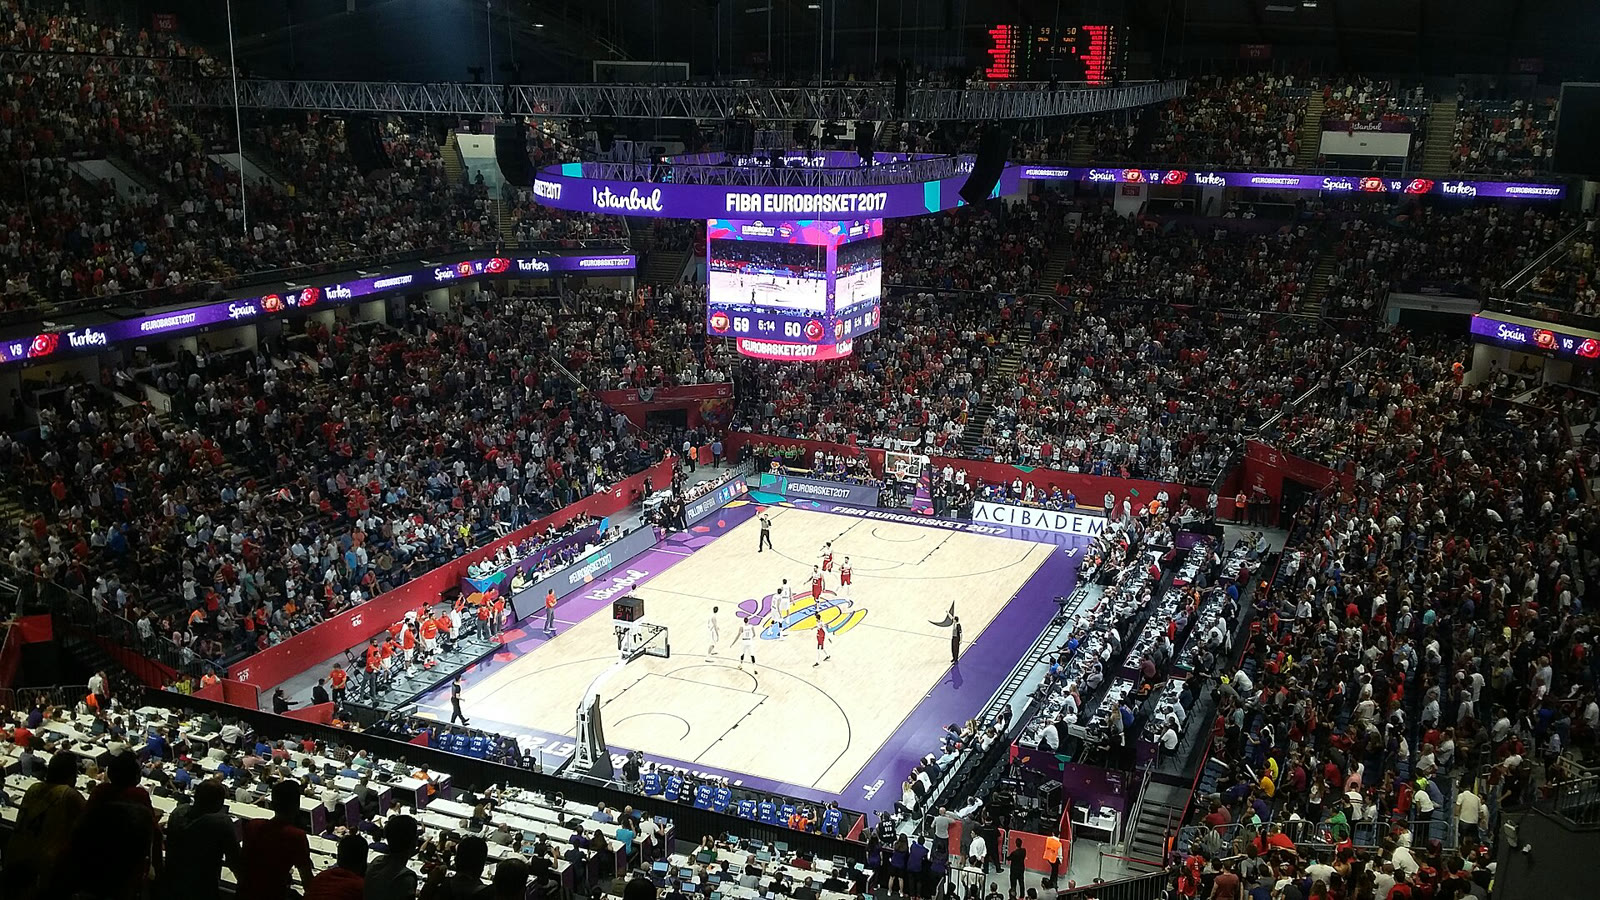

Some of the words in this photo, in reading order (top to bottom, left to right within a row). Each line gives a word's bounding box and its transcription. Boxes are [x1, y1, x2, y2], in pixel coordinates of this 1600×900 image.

[1088, 170, 1116, 182] Spain
[1195, 172, 1226, 186] Turkey
[1322, 178, 1352, 191] Spain
[1442, 182, 1476, 196] Turkey
[592, 186, 663, 211] Istanbul
[1506, 186, 1560, 195] #EUROBASKET2017
[726, 192, 761, 212] FIBA
[434, 267, 454, 280] Spain
[517, 258, 549, 272] Turkey
[228, 303, 256, 320] Spain
[325, 285, 351, 299] Turkey
[141, 313, 196, 331] #EUROBASKET2017
[68, 328, 106, 347] Turkey
[1498, 324, 1526, 342] Spain
[788, 483, 850, 498] #EUROBASKET2017
[687, 504, 704, 519] FOLLOW
[831, 506, 867, 516] FIBA
[866, 511, 966, 529] EUROBASKET
[965, 524, 1007, 534] 2017
[975, 504, 1104, 534] ACIBADEM
[569, 553, 611, 584] #EUROBASKET2017
[584, 570, 649, 600] Istanbul
